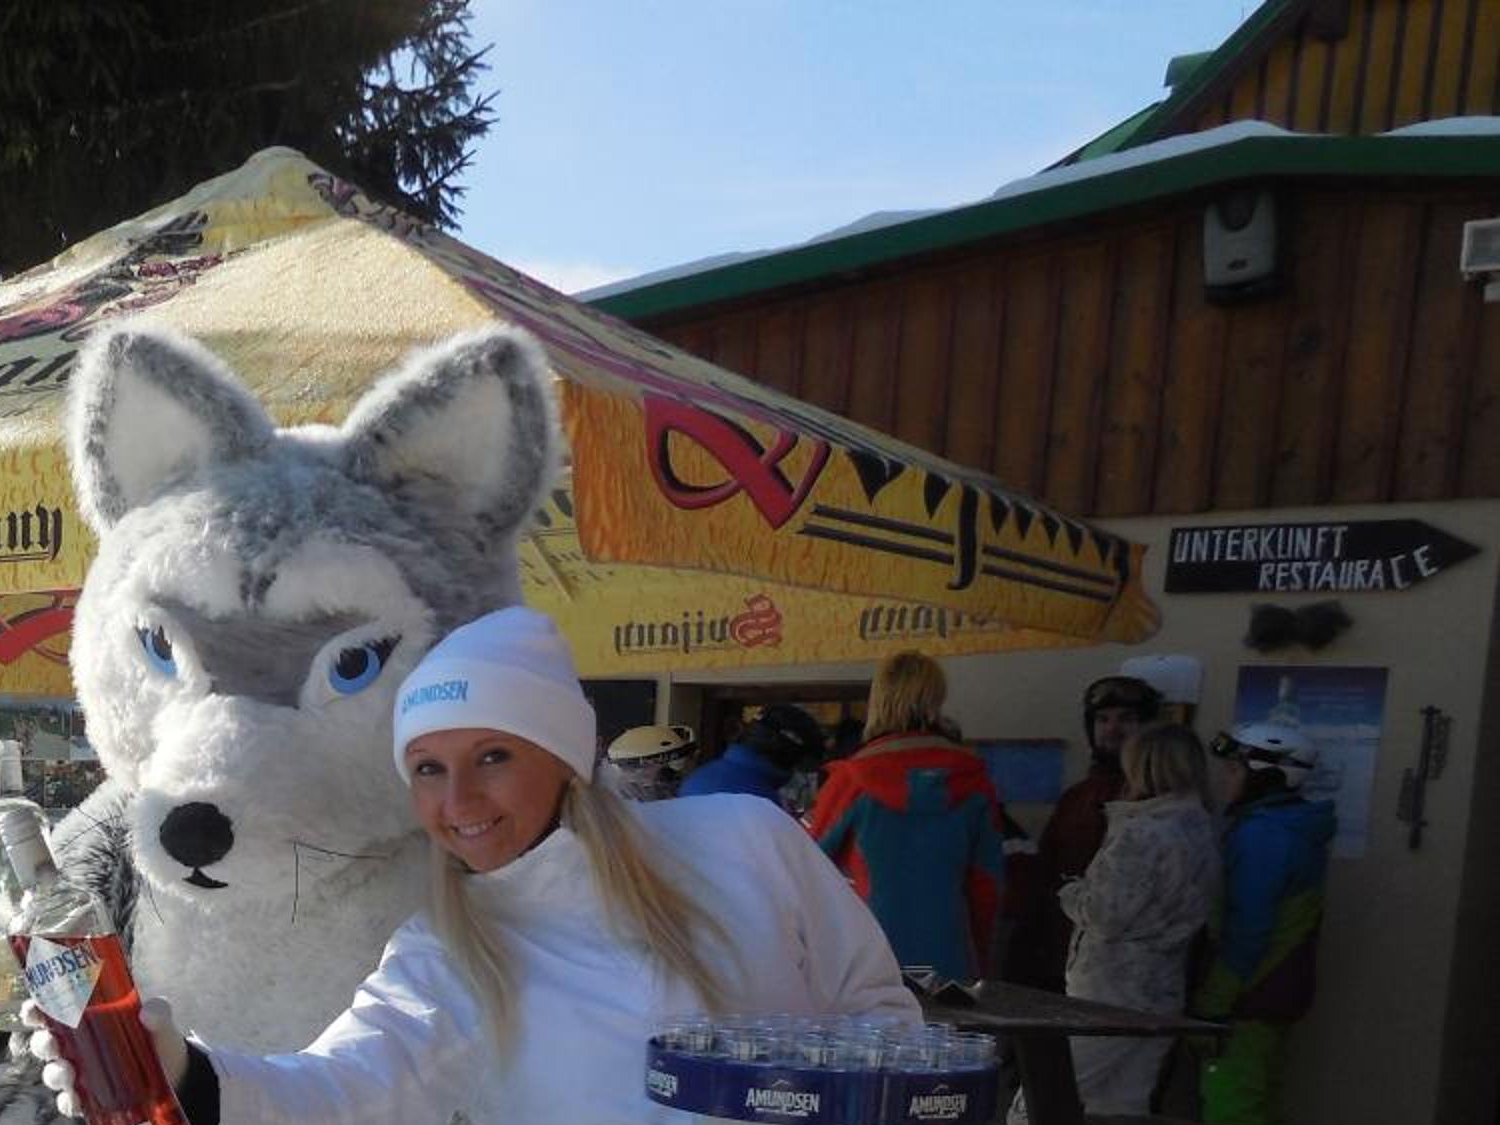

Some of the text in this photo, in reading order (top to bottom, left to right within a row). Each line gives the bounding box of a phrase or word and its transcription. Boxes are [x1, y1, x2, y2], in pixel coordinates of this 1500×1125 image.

[1172, 525, 1348, 564] UNTERKUNFT
[1257, 545, 1439, 591] RESTAURACE
[402, 679, 468, 714] AMUNDSEN
[745, 1086, 821, 1114] AMUNDSEN
